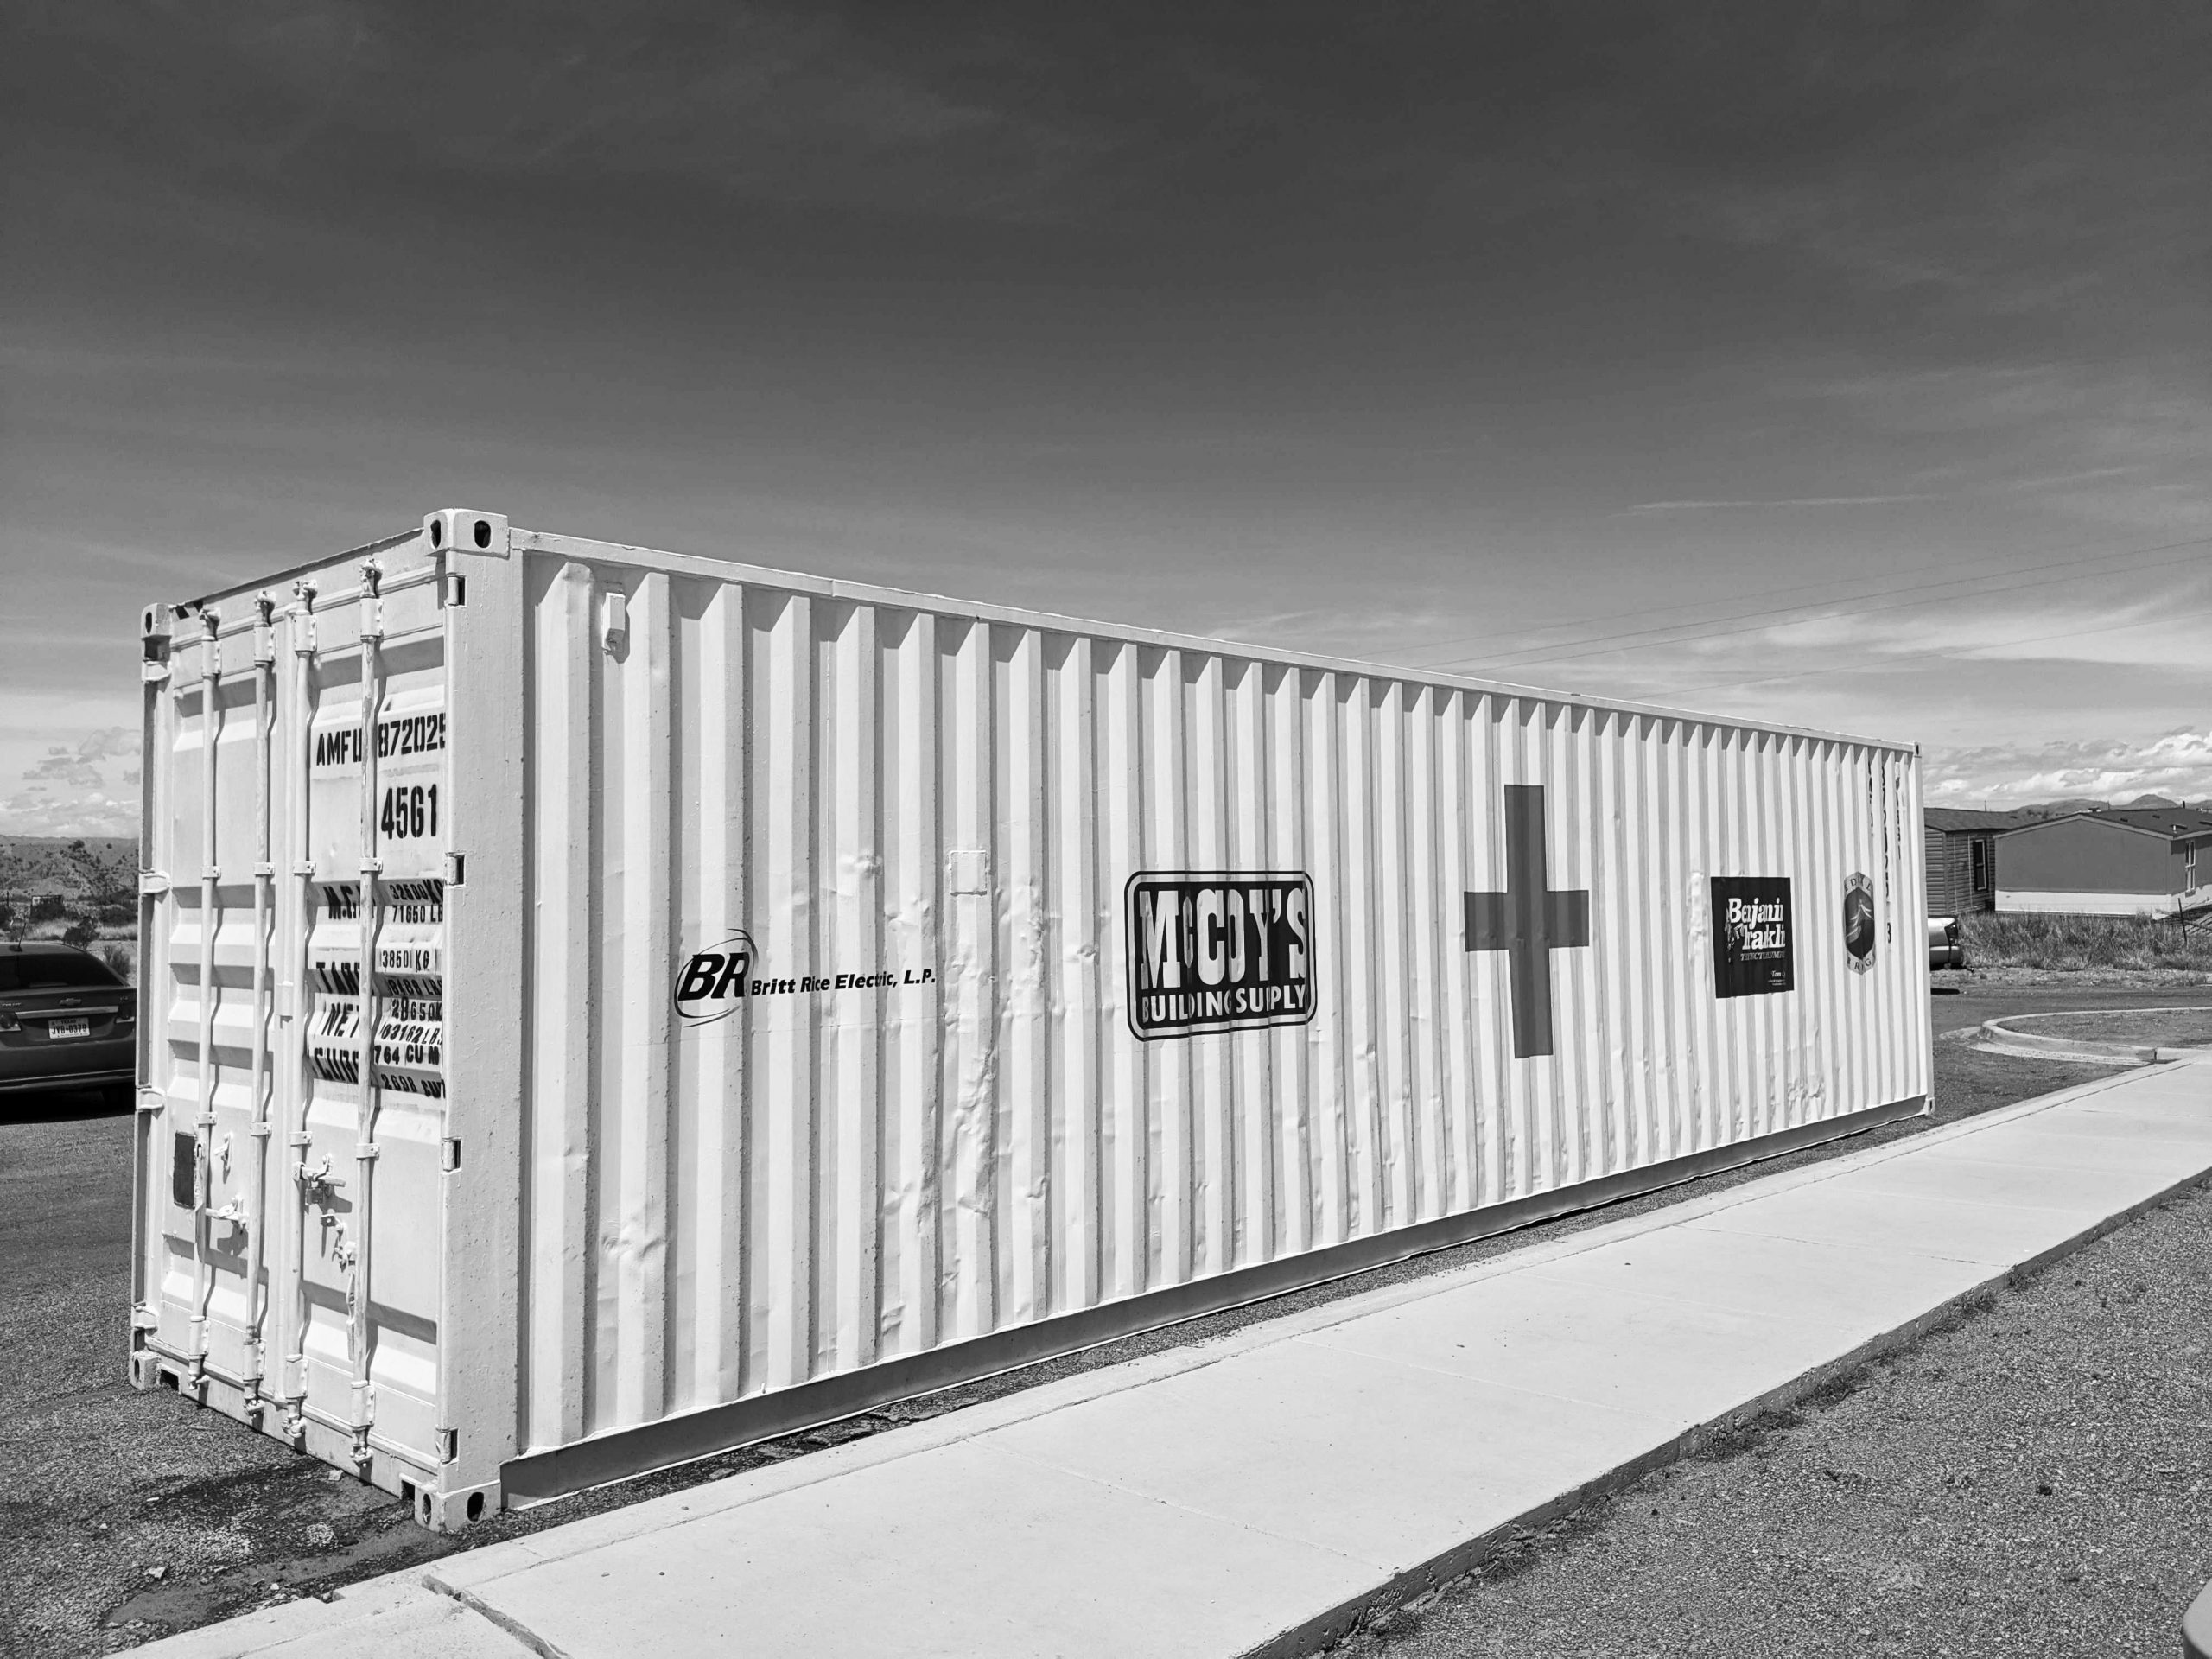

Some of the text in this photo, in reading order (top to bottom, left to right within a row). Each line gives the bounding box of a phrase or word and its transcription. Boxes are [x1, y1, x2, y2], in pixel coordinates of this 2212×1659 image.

[316, 728, 362, 766] AMFU
[381, 784, 437, 840] 45G1
[416, 950, 430, 971] KG
[678, 951, 750, 1001] BR
[751, 978, 796, 996] Britt
[800, 976, 830, 993] Rice
[904, 969, 936, 985] L.P.
[1141, 983, 1306, 1024] BUILDING SUPPLY
[406, 1044, 423, 1064] CU
[429, 1045, 440, 1065] M
